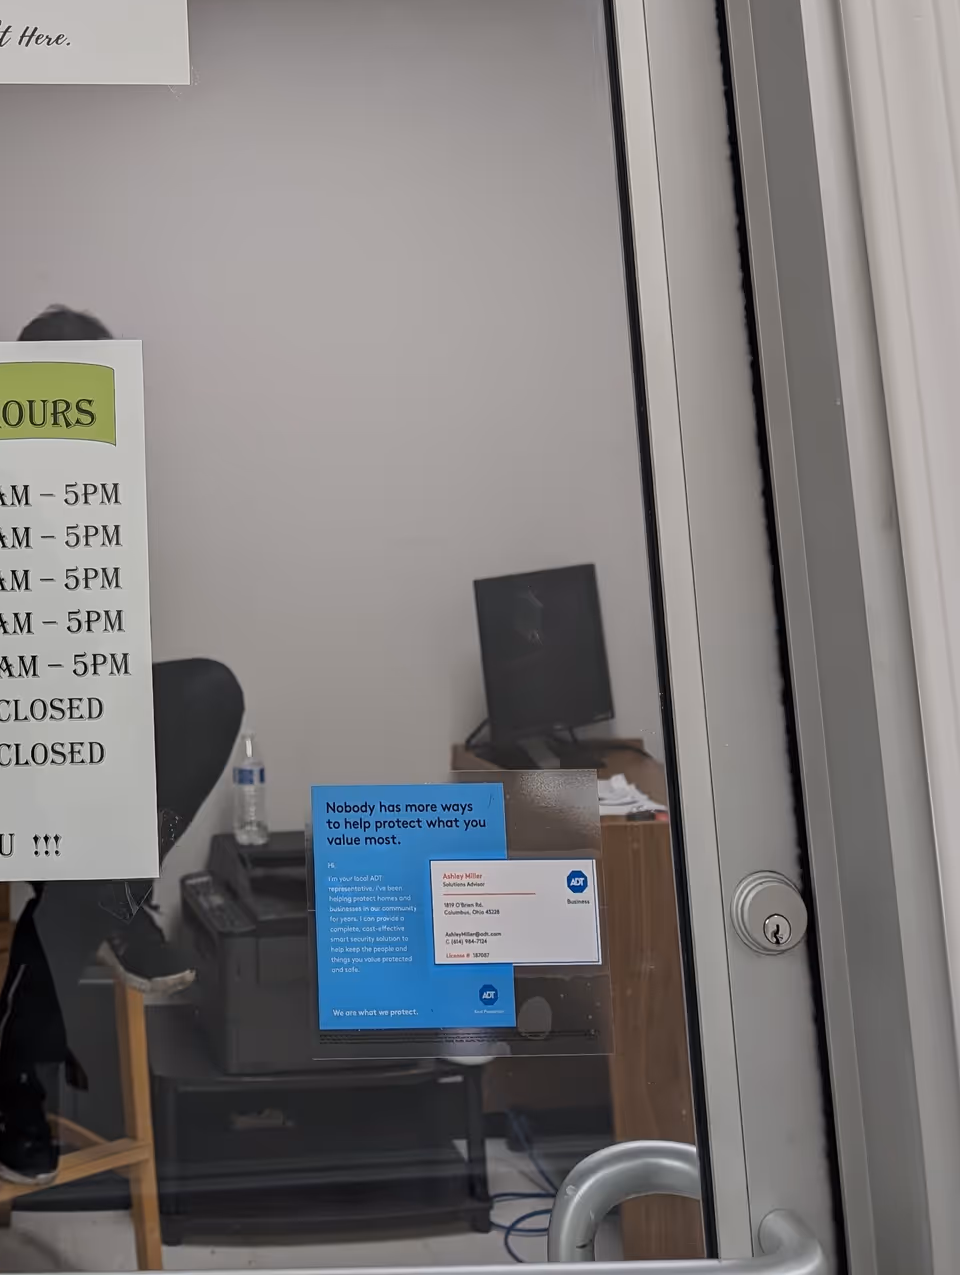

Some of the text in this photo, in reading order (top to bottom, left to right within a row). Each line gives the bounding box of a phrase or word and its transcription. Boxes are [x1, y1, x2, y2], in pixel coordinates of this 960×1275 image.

[18, 26, 71, 48] Here.
[63, 482, 122, 507] 5PM
[64, 524, 122, 549] 5PM
[63, 567, 122, 591] 5PM
[66, 610, 126, 633] 5PM
[72, 653, 131, 676] 5PM
[326, 801, 473, 814] Nobody has more ways
[326, 817, 486, 831] to help protect what you
[33, 834, 63, 857] !!!
[327, 835, 401, 845] value most.
[570, 878, 584, 886] ADT
[482, 991, 495, 999] ADT
[390, 1008, 418, 1017] protect.
